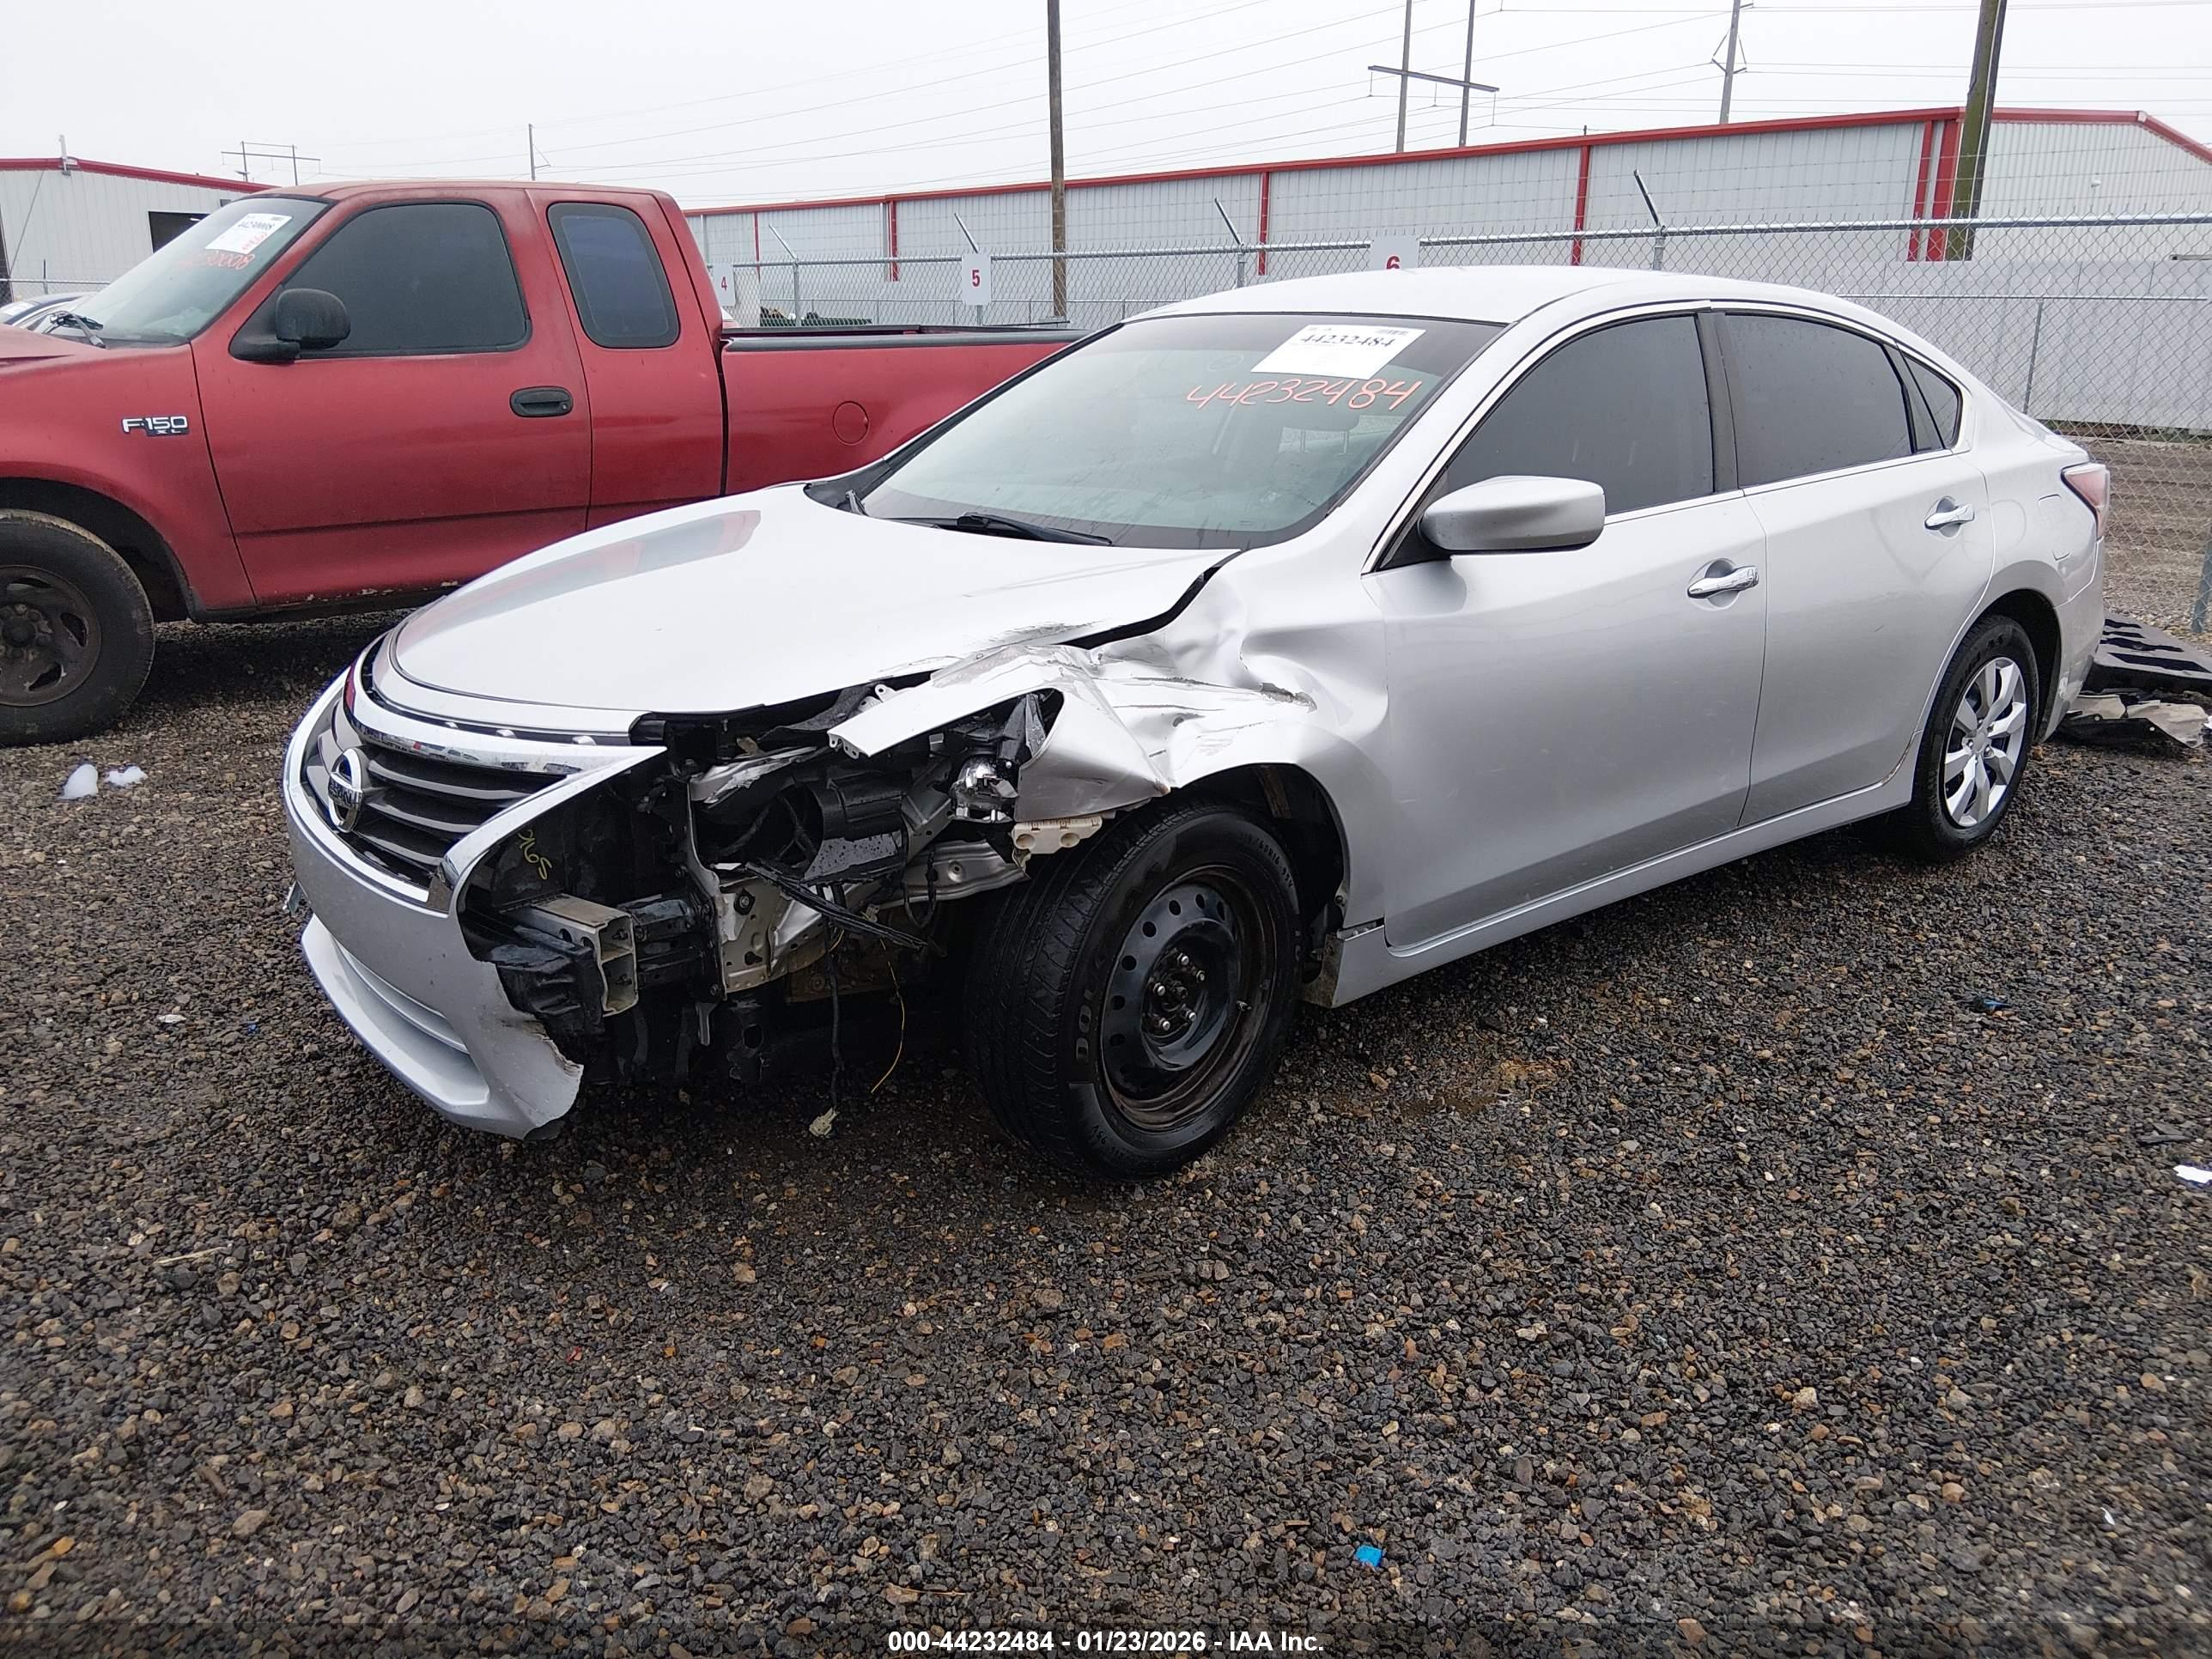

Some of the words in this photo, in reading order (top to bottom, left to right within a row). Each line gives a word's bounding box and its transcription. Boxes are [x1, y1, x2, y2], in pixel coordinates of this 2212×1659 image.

[1386, 255, 1401, 270] 6
[720, 276, 728, 291] 4
[971, 269, 981, 288] 5
[1300, 334, 1395, 348] 44232484
[1185, 378, 1423, 411] 44232484
